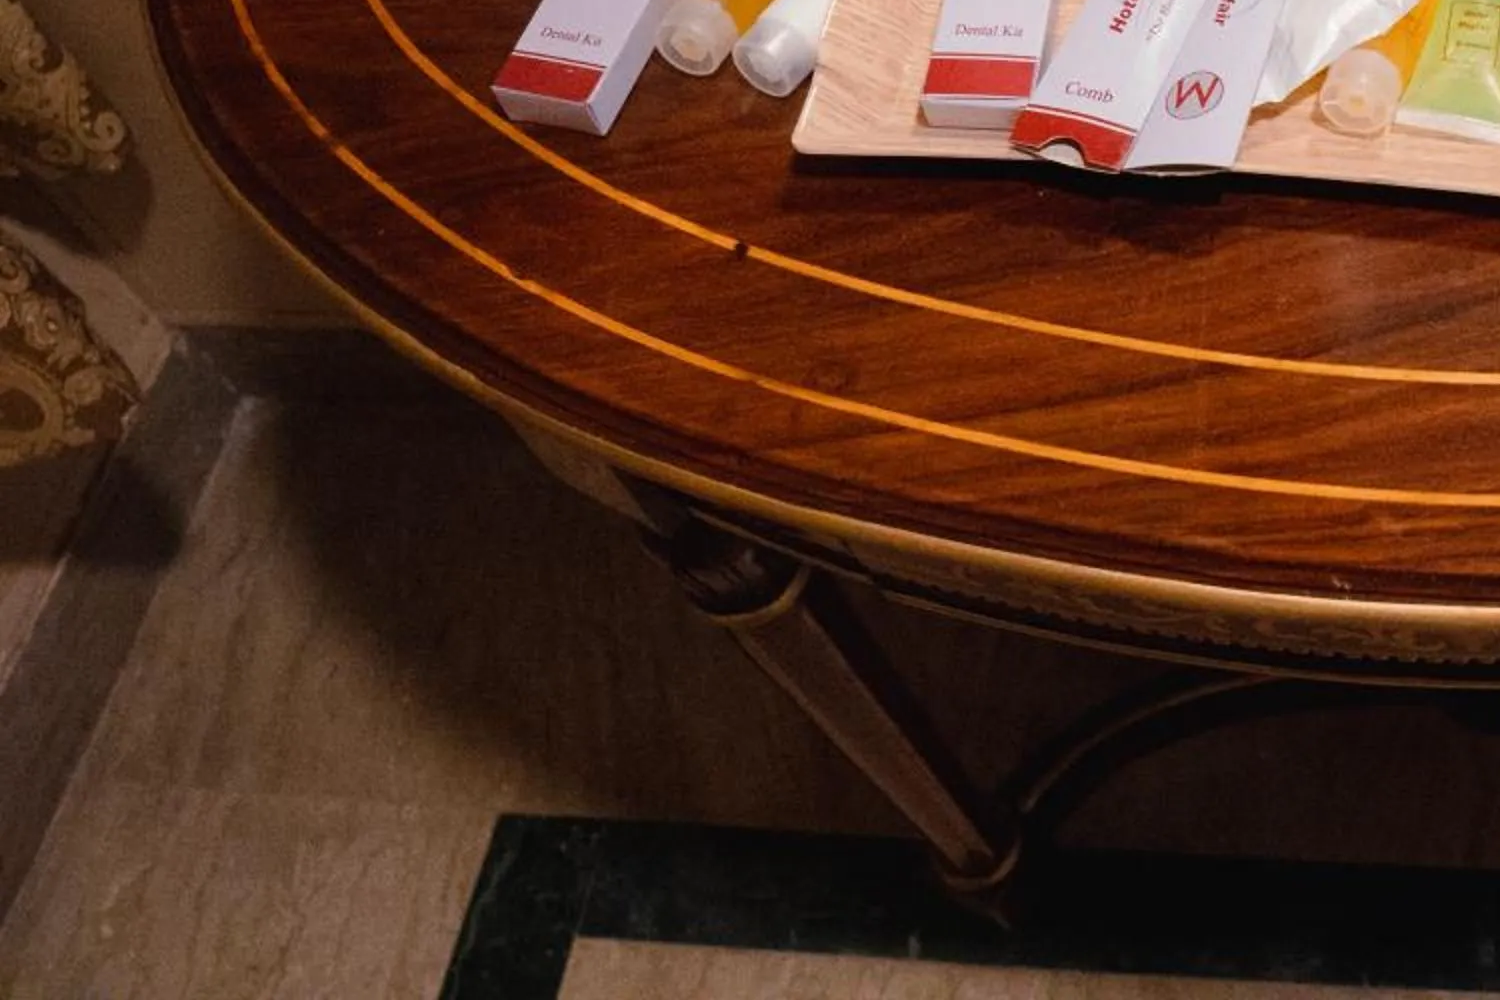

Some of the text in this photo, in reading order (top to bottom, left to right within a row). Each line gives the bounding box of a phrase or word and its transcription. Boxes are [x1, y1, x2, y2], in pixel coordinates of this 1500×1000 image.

[954, 23, 1024, 38] Dental Kit
[1065, 80, 1115, 103] Comb
